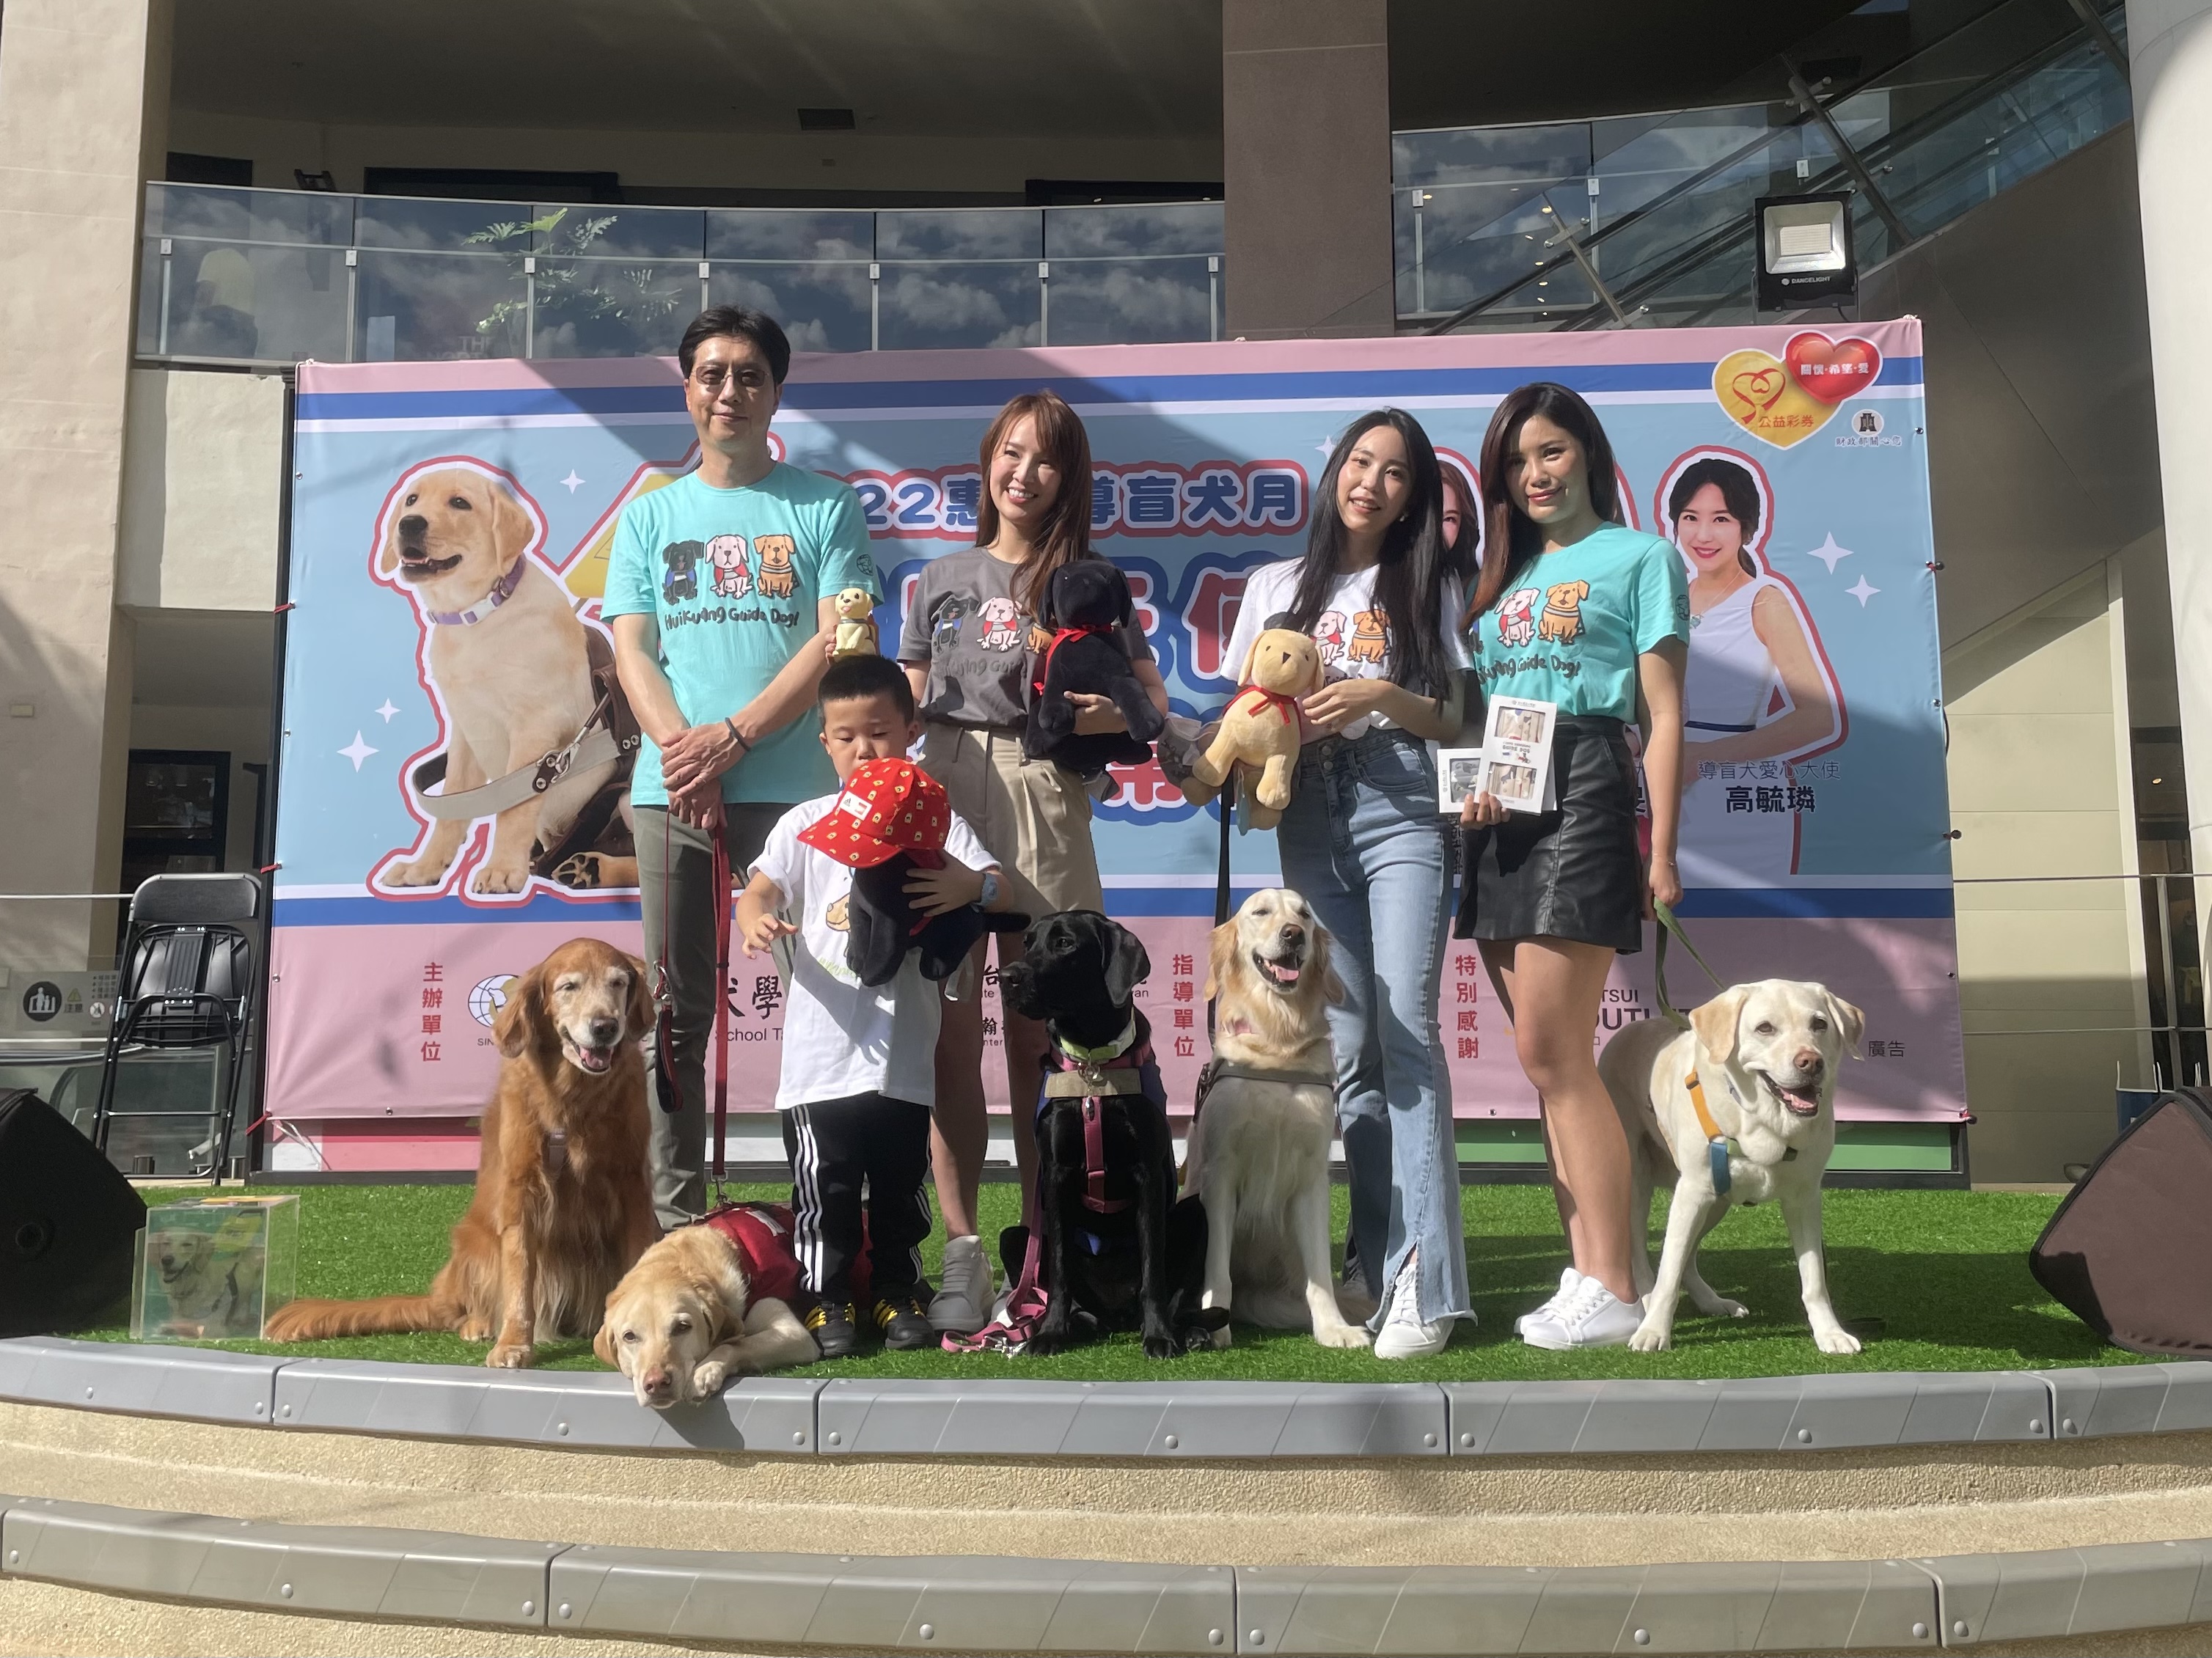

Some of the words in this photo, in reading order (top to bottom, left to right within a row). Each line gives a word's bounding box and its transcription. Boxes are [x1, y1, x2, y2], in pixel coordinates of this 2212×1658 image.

[1759, 414, 1814, 428] 公益彩券
[1698, 760, 1841, 780] 導盲犬愛心大使
[1726, 785, 1815, 813] 高毓璘
[420, 961, 443, 1062] 主辦單位
[1173, 954, 1195, 1057] 指導單位
[1455, 955, 1479, 1060] 特別感謝
[715, 1027, 767, 1042] chool
[772, 1028, 783, 1041] T
[1868, 1041, 1905, 1057] 廣告
